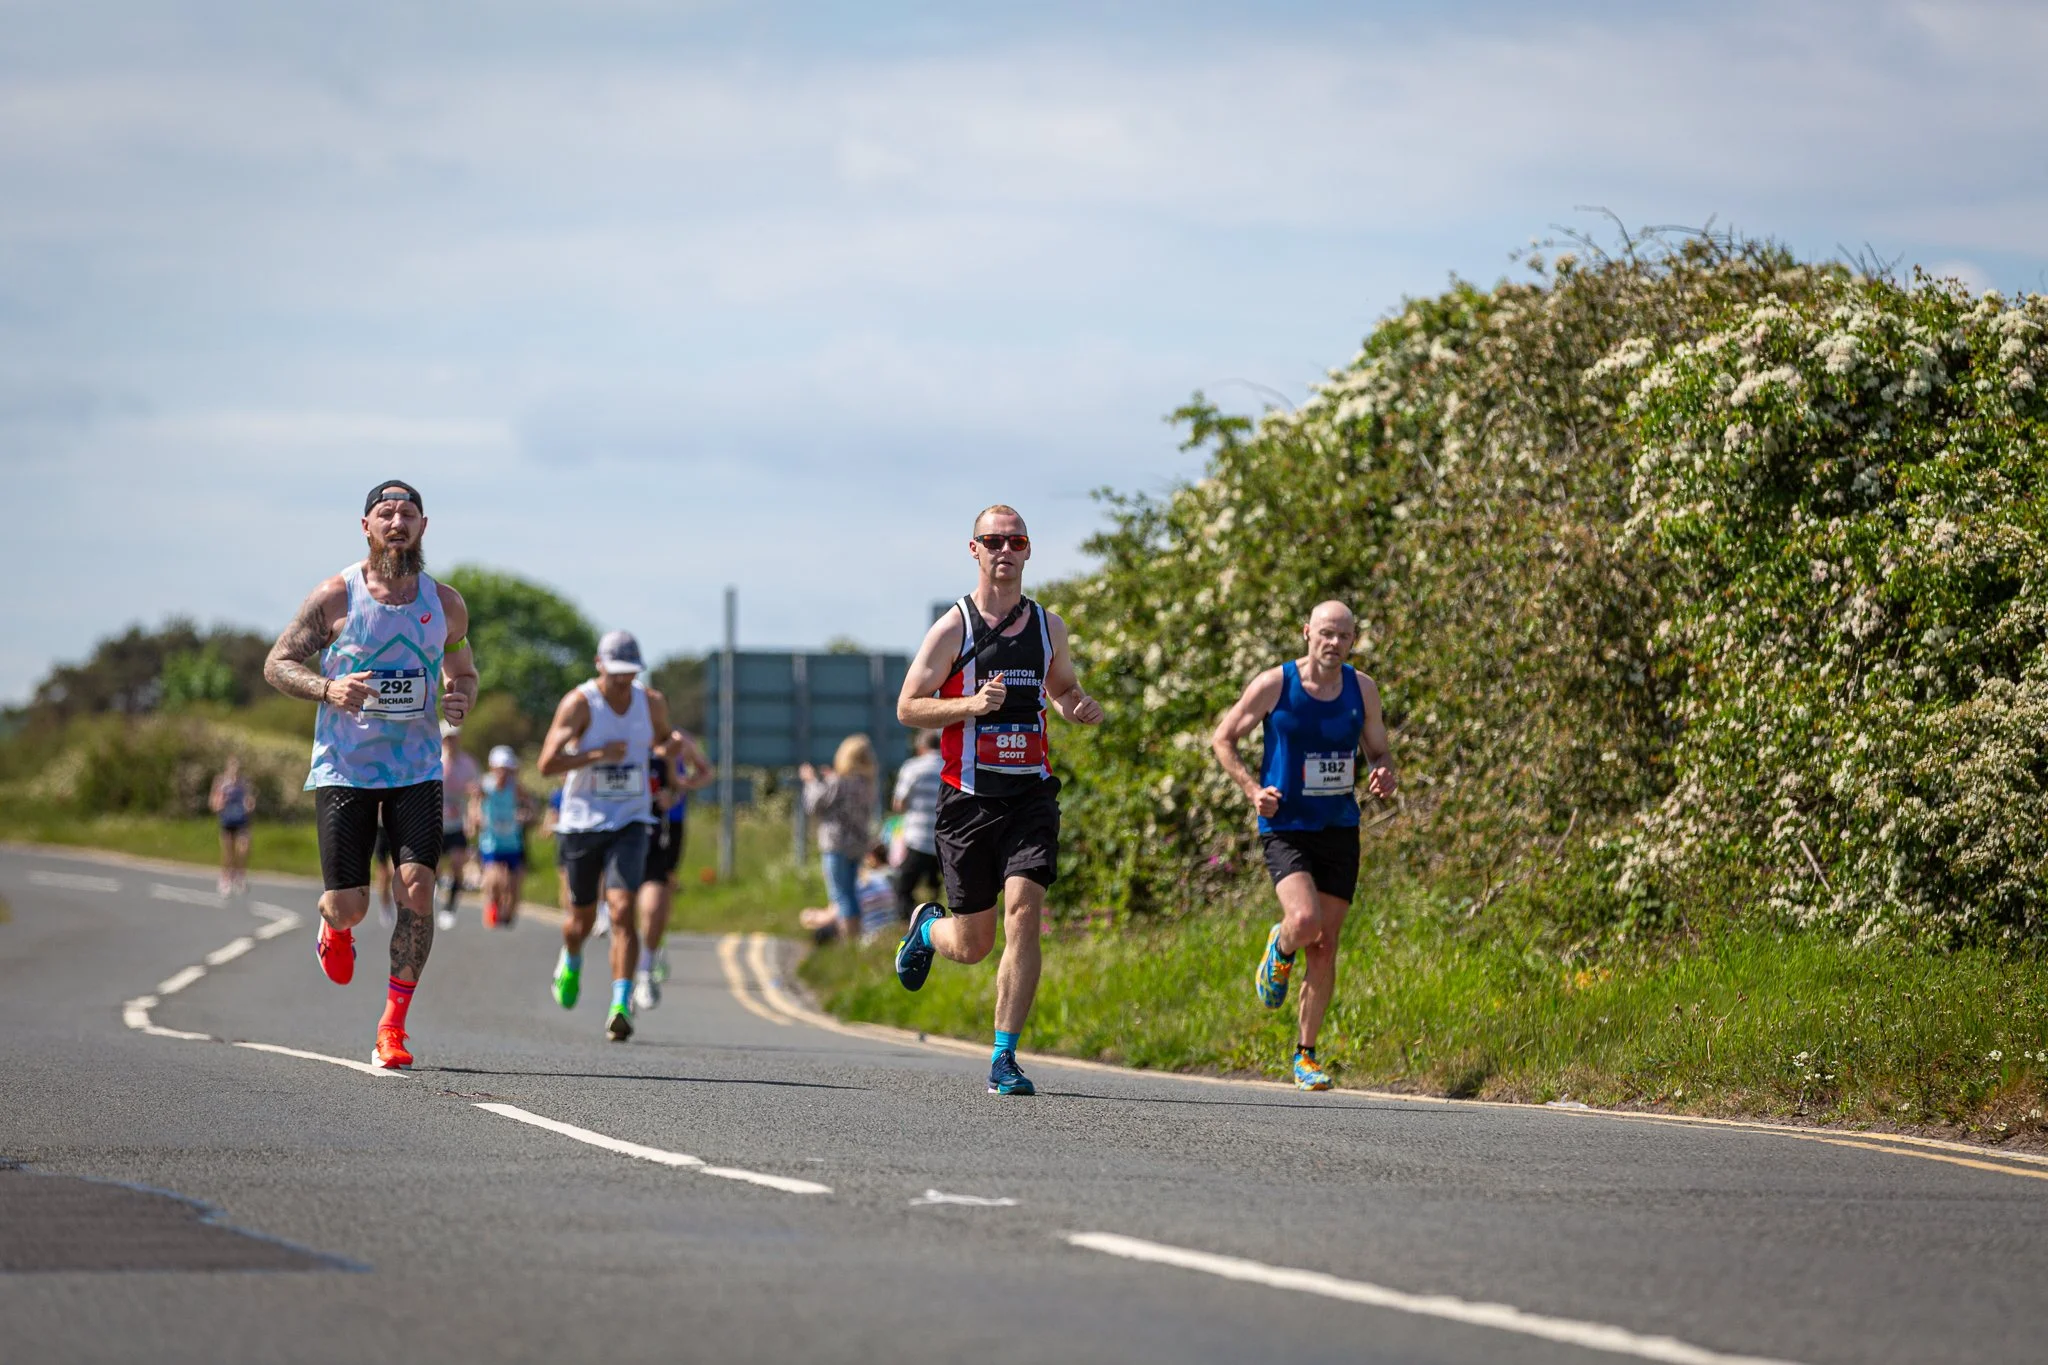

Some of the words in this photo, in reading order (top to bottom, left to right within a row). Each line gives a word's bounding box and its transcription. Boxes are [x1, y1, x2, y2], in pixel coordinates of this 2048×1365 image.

[380, 680, 413, 694] 292
[378, 697, 414, 705] RICHARD
[996, 734, 1028, 749] 818
[998, 750, 1026, 759] SCOTT
[1319, 761, 1346, 774] 382
